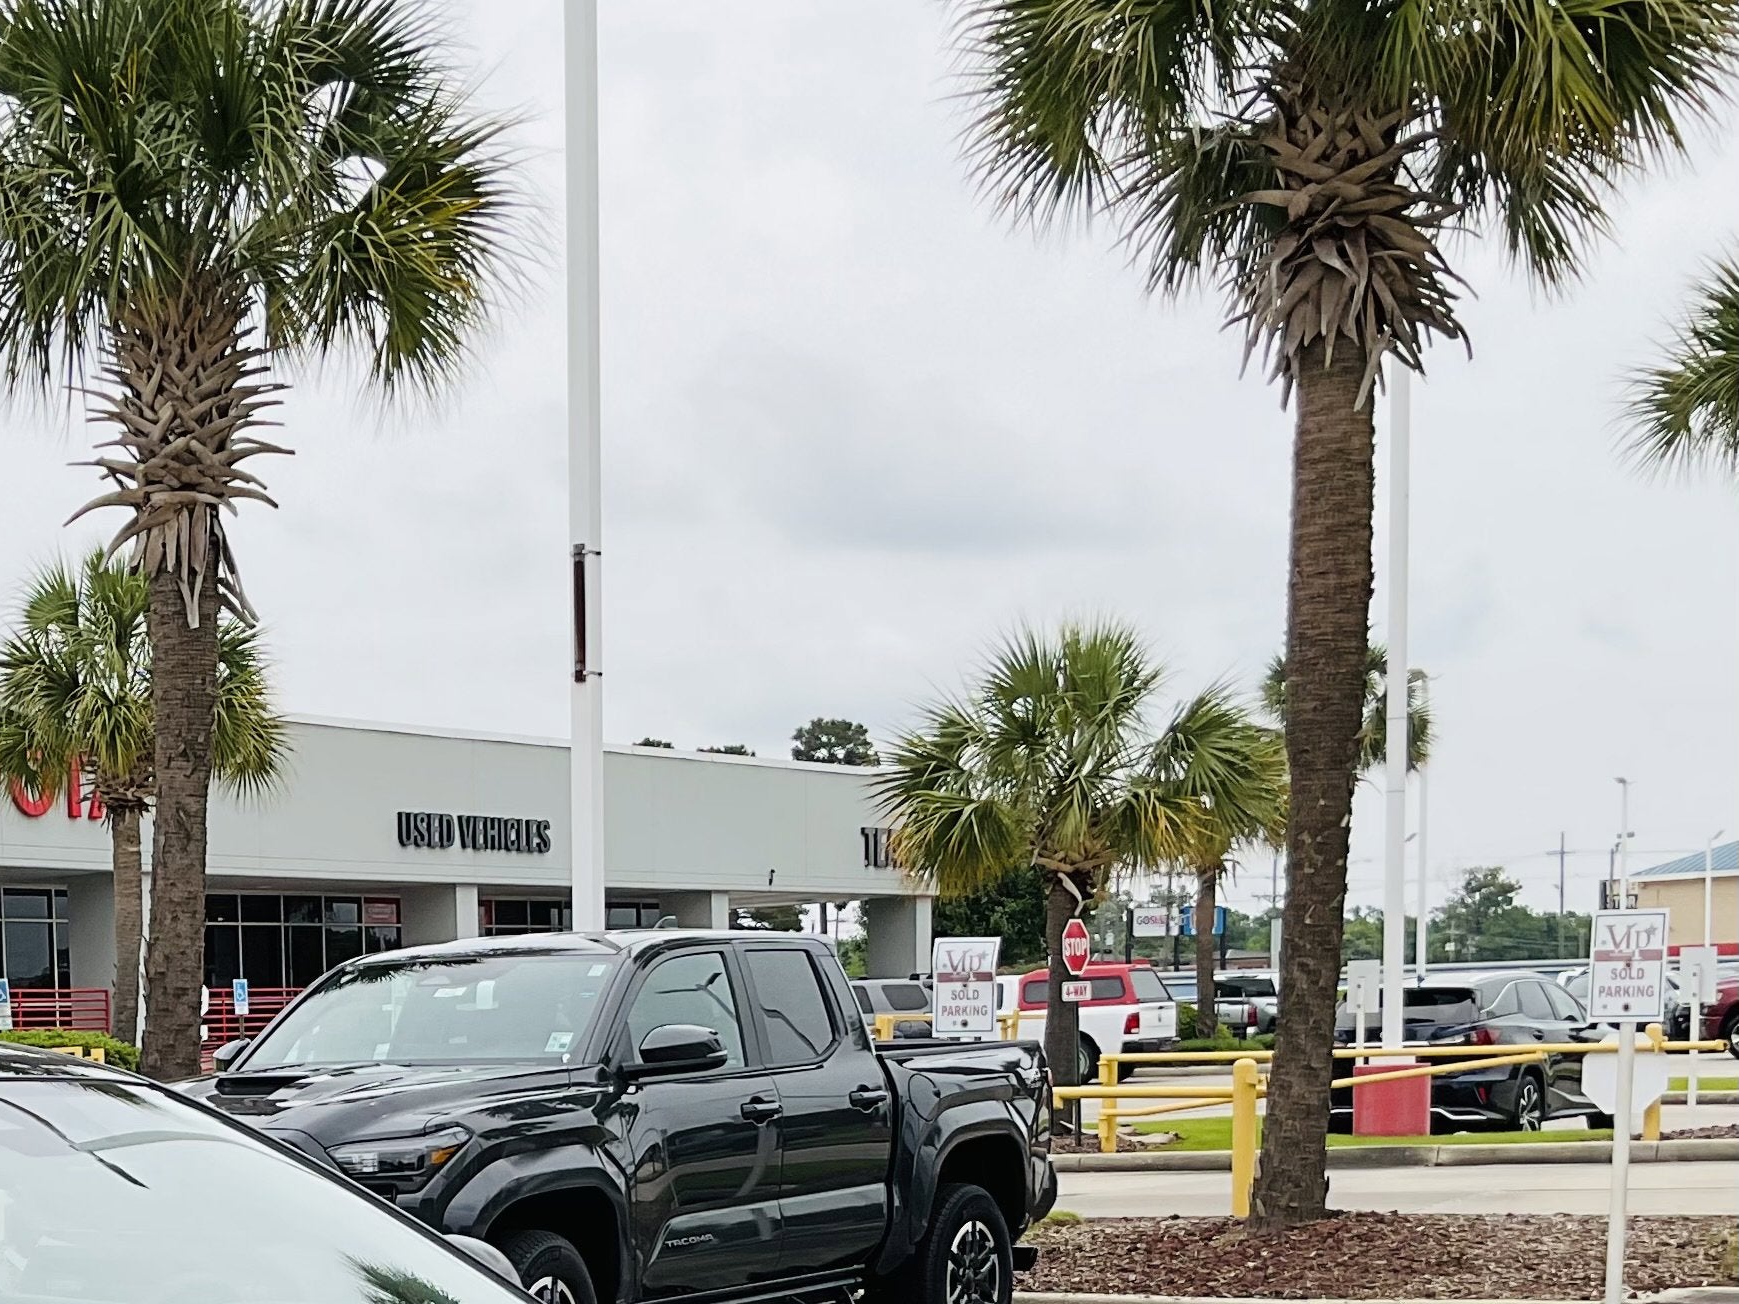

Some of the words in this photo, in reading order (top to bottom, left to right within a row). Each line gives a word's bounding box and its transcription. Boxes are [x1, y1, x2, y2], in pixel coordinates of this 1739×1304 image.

[397, 811, 456, 849] USED
[457, 815, 551, 853] VEHICLES
[1065, 937, 1088, 957] STOP
[1610, 967, 1645, 981] SOLD
[951, 989, 980, 1001] SOLD
[1065, 985, 1088, 997] 4-WAY
[1598, 985, 1655, 998] PARKING
[941, 1004, 988, 1017] PARKING
[665, 1233, 715, 1248] TACOMA
